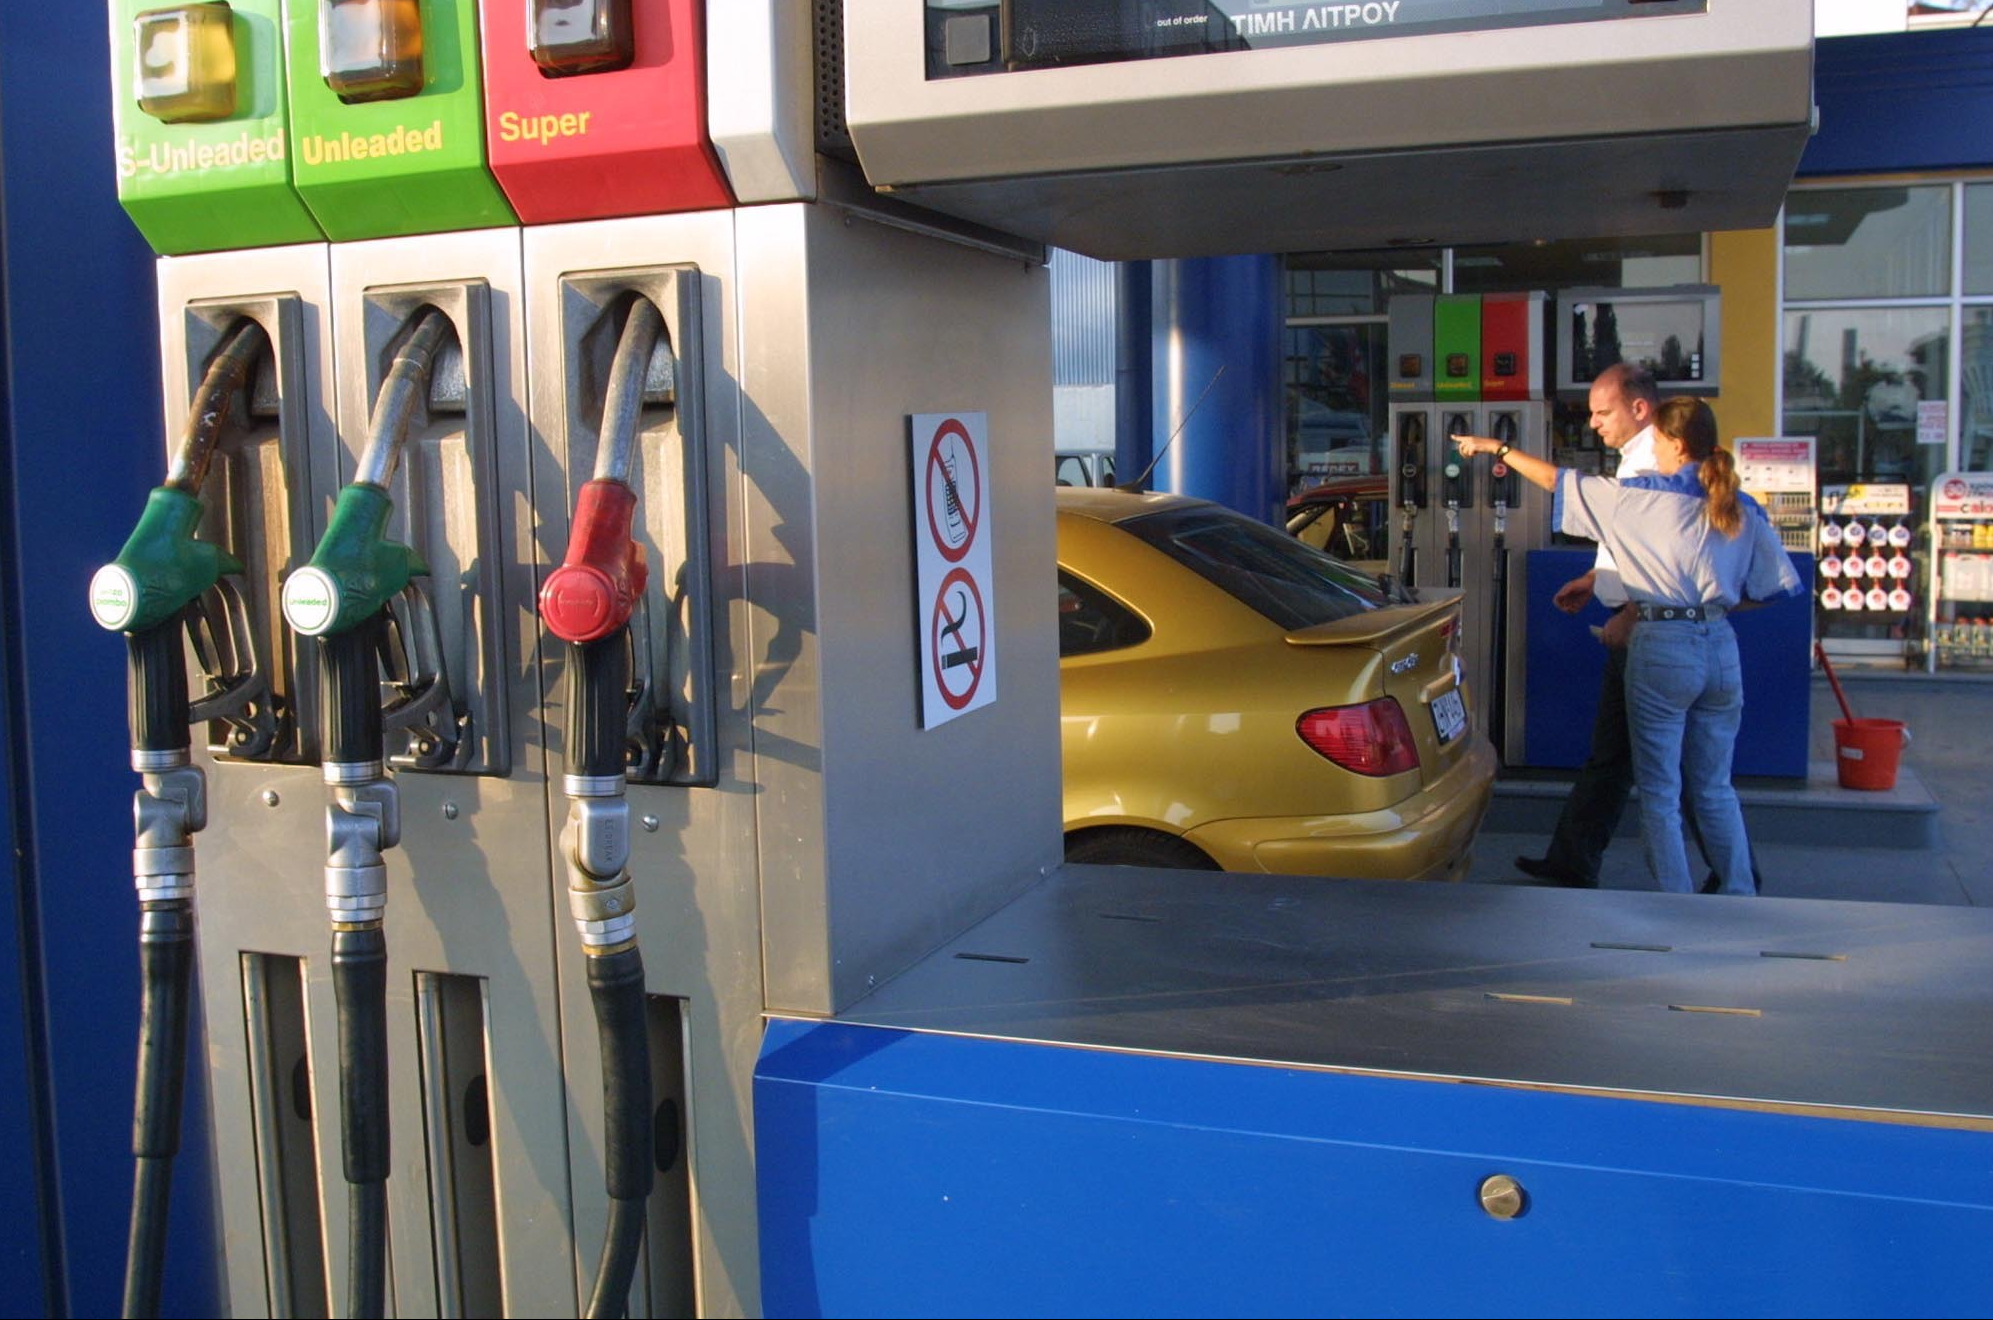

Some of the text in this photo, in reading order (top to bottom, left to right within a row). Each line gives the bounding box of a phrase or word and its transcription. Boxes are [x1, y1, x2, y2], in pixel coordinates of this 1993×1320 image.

[1156, 14, 1209, 27] out of order
[1231, 1, 1401, 36] ΤΙΜΗ ΛΙΤΡΟΥ
[302, 121, 443, 167] Unleaded
[500, 111, 592, 144] Super
[117, 128, 285, 174] S-Unleaded
